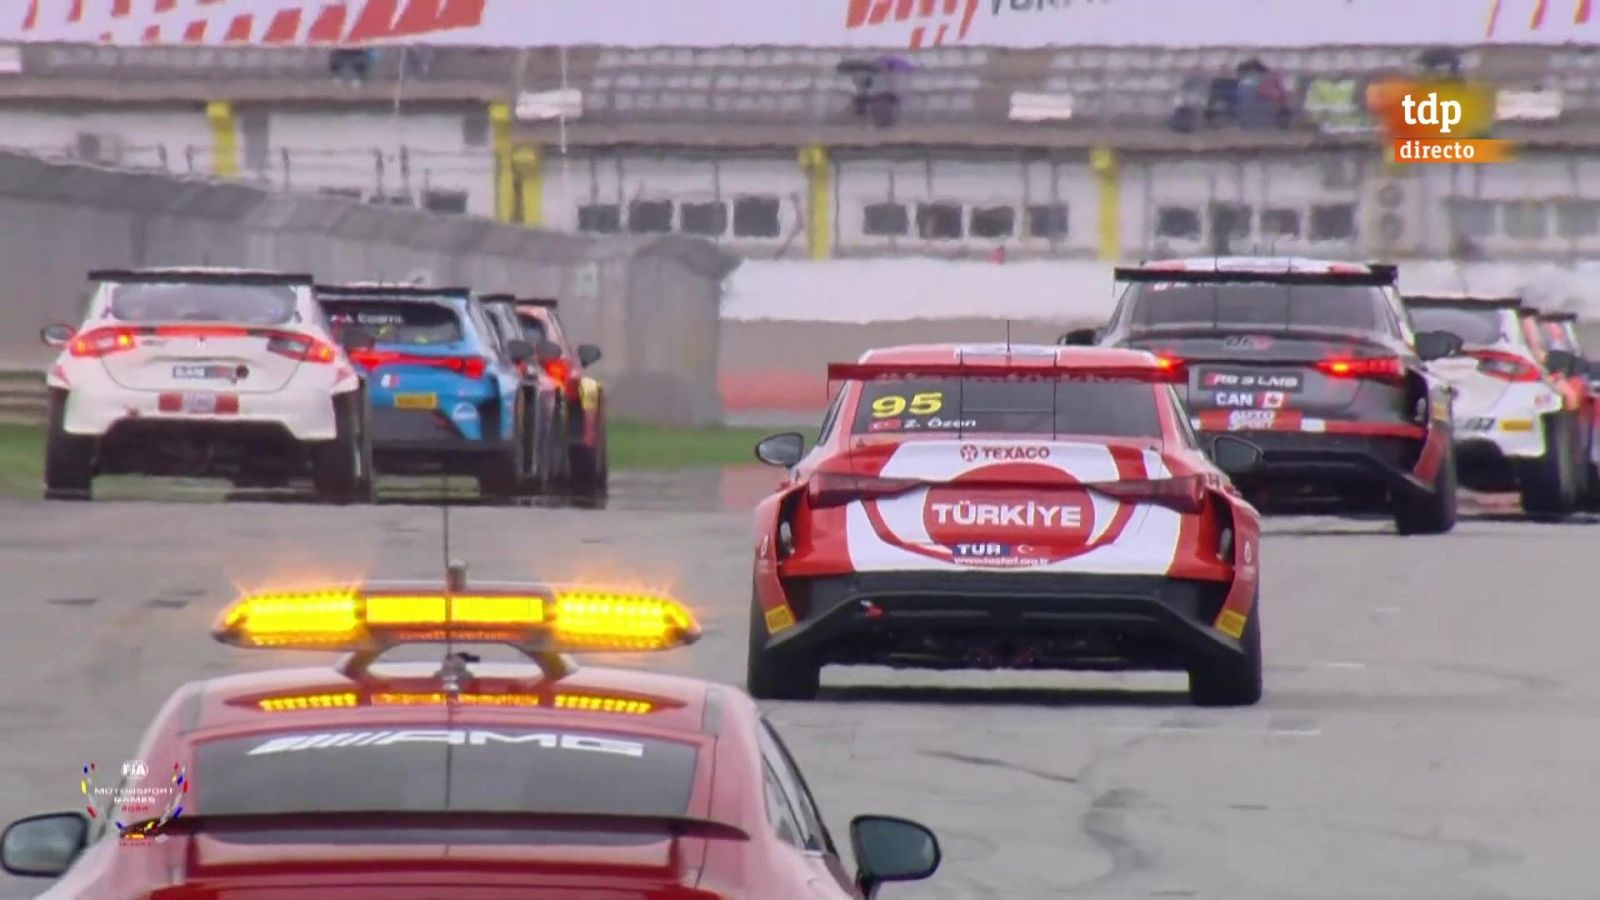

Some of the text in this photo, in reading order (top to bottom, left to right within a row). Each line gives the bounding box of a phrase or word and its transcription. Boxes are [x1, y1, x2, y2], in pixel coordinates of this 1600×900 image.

[871, 392, 943, 418] 95
[1215, 391, 1253, 407] CAN
[981, 446, 1051, 460] TEXACO
[931, 500, 1082, 529] TÜRKİYE
[957, 543, 1002, 556] TUR
[376, 729, 644, 758] AMG
